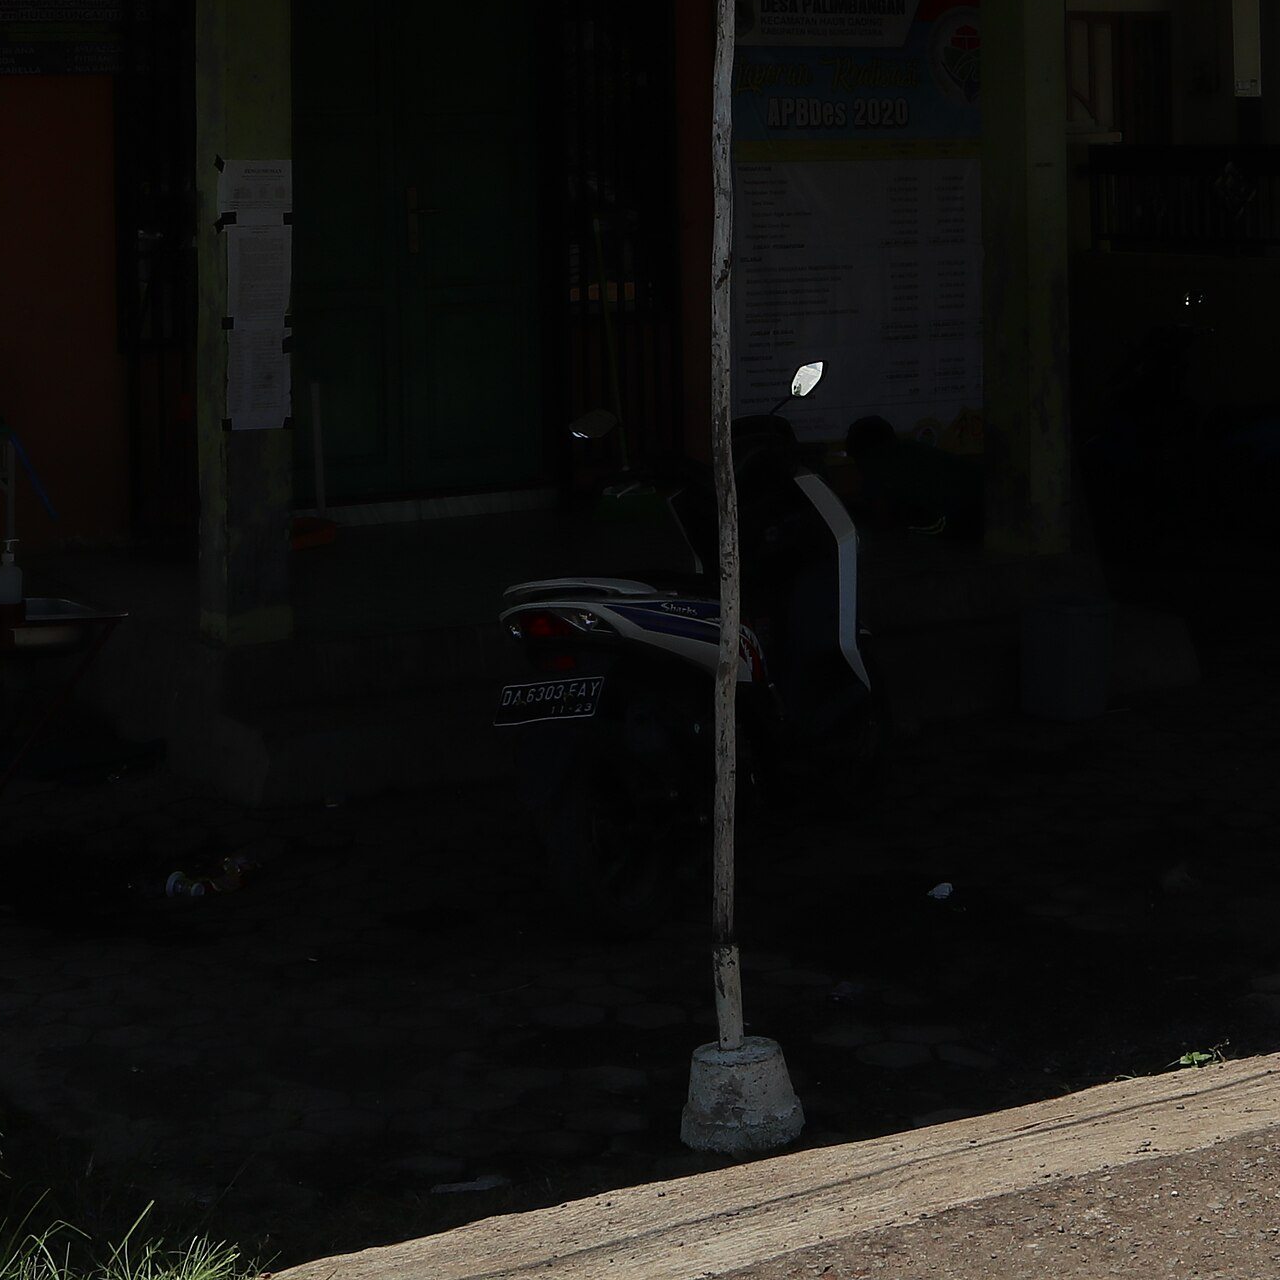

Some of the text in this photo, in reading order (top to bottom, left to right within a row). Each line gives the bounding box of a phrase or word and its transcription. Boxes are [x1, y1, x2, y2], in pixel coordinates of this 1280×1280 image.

[768, 96, 910, 129] APBDes 2020
[660, 601, 699, 616] Sharks
[501, 689, 522, 707] DA
[526, 684, 565, 704] 6303
